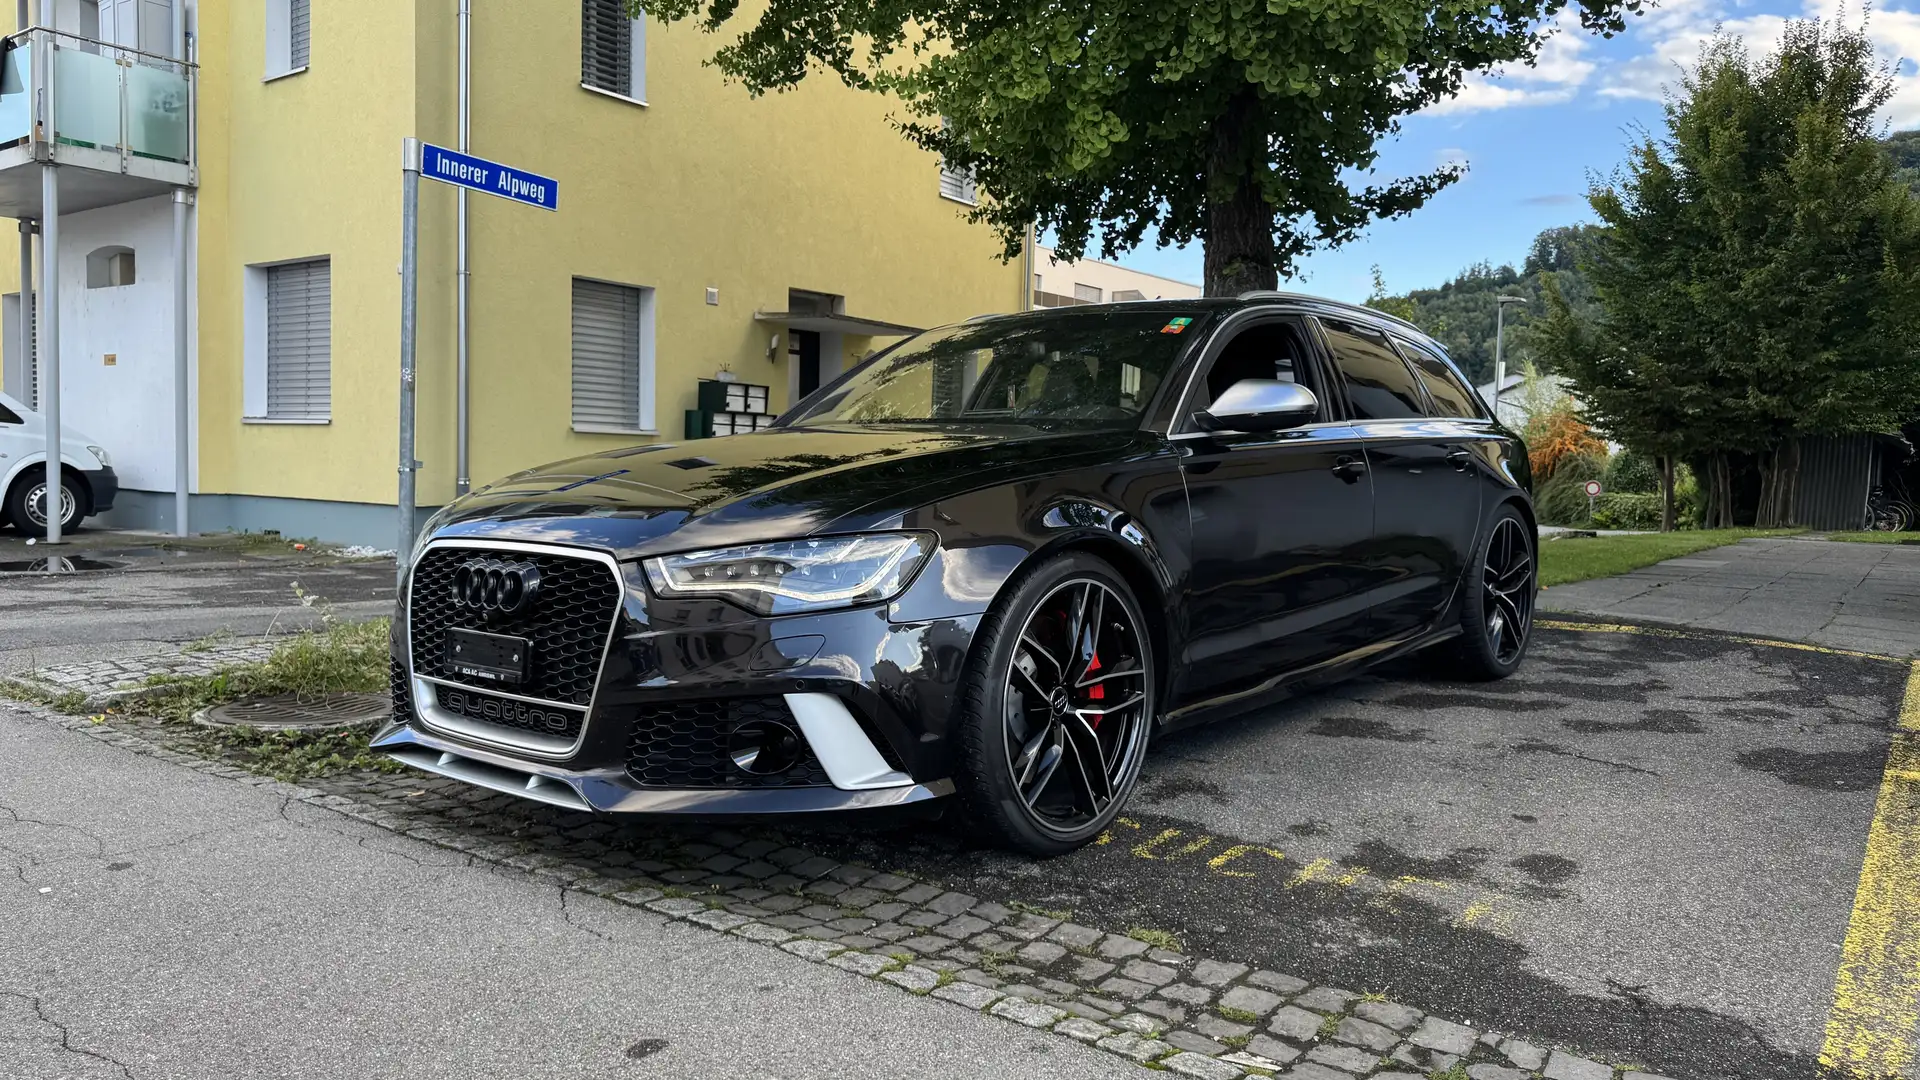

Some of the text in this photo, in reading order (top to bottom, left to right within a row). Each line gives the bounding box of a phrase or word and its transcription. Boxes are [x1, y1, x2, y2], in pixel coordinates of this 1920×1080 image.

[437, 152, 545, 203] Innerer Alpweg
[448, 692, 568, 730] quattro
